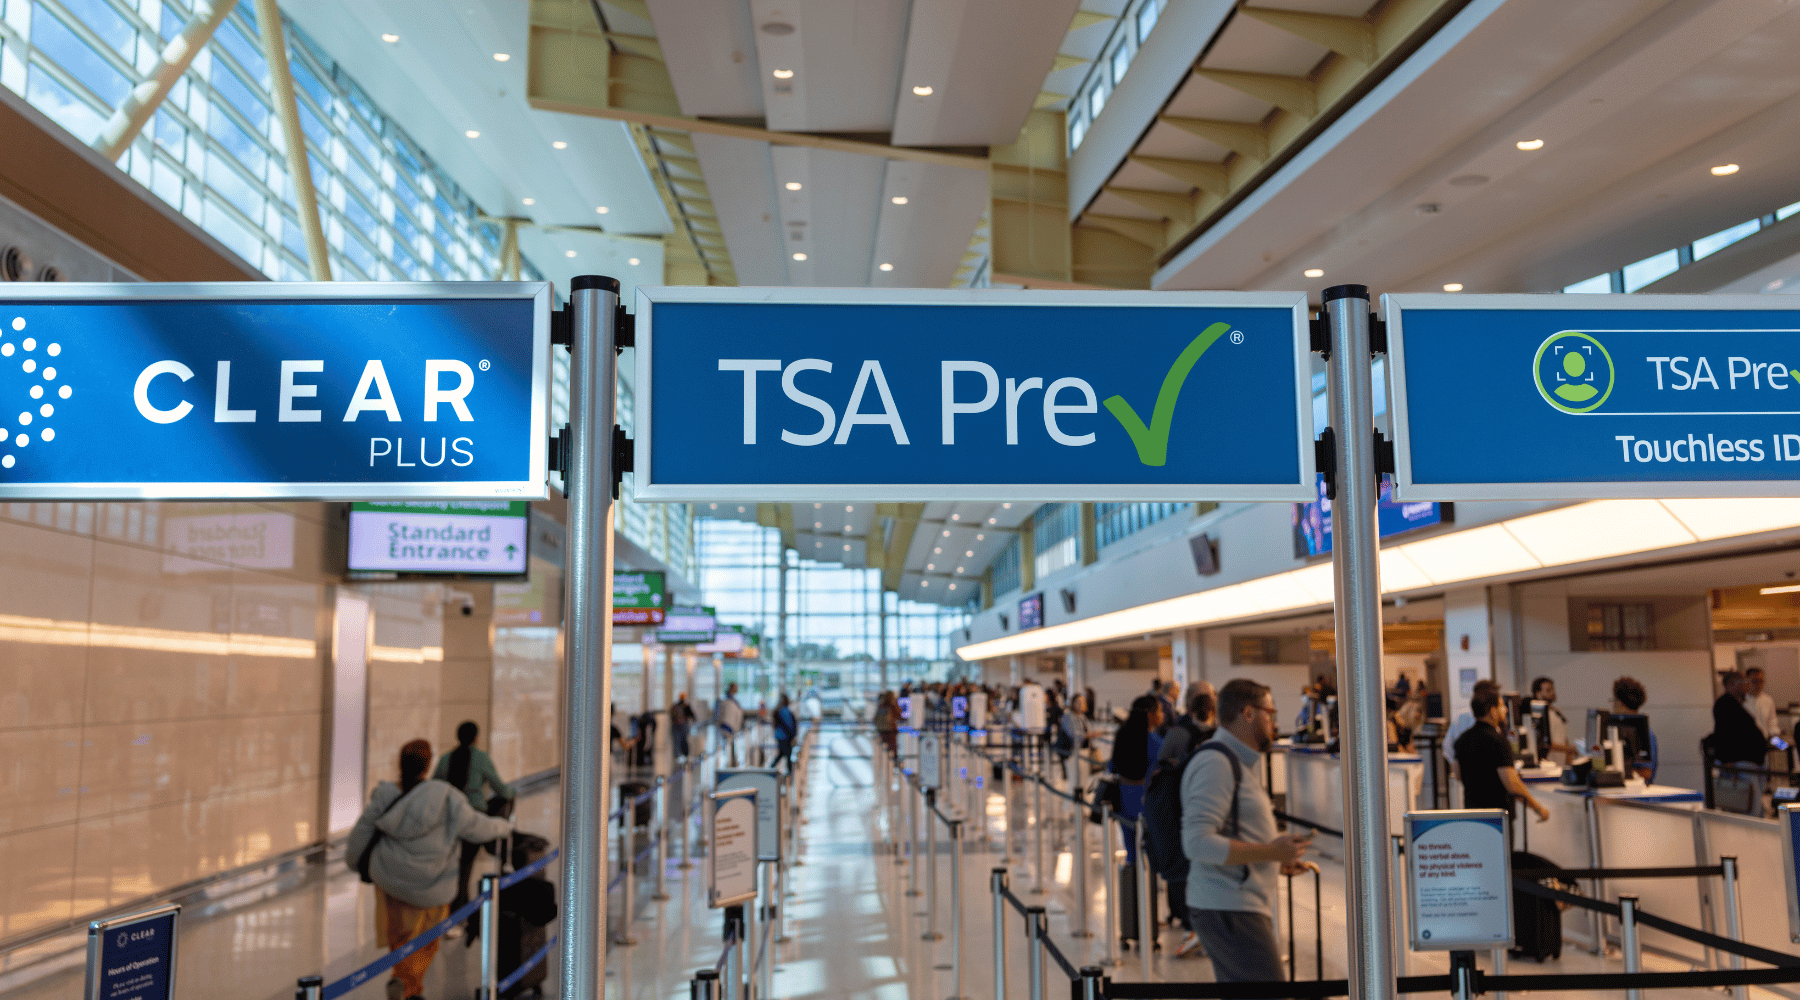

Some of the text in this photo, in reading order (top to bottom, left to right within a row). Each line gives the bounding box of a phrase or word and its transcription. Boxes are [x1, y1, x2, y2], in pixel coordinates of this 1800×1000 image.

[1646, 356, 1789, 391] TSA Pre
[718, 358, 911, 447] TSA
[941, 360, 1098, 447] Pre
[369, 436, 474, 467] PLUS
[1615, 433, 1800, 463] Touchless ID
[388, 522, 491, 543] Standard
[388, 541, 490, 560] Entrance
[130, 928, 155, 941] CLEAR
